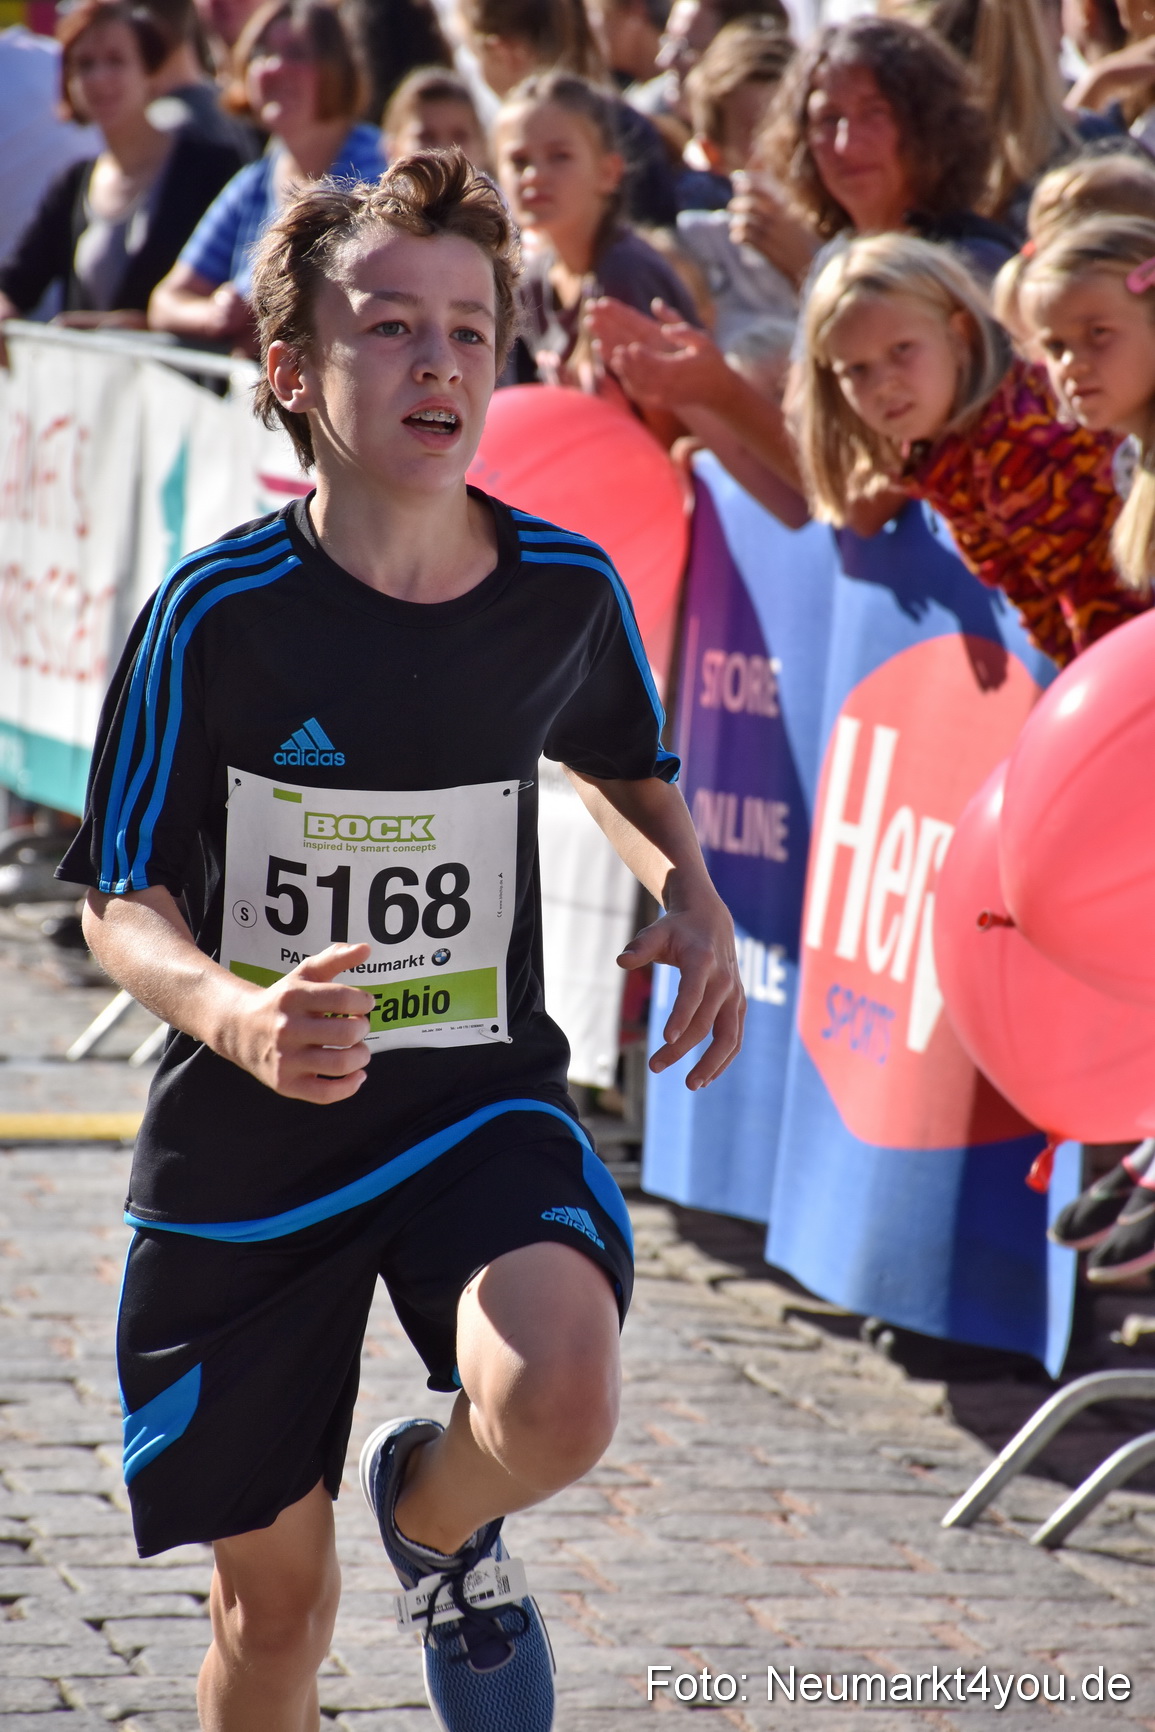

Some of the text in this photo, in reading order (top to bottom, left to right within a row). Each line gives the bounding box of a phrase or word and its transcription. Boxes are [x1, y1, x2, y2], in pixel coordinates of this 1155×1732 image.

[700, 648, 782, 718] STORE
[273, 749, 345, 766] adidas
[304, 812, 436, 842] BOCK
[303, 840, 437, 853] inspired by smart concepts
[240, 906, 249, 922] S
[265, 855, 471, 945] 5168
[821, 984, 896, 1064] SPORTS
[541, 1210, 605, 1250] adidas
